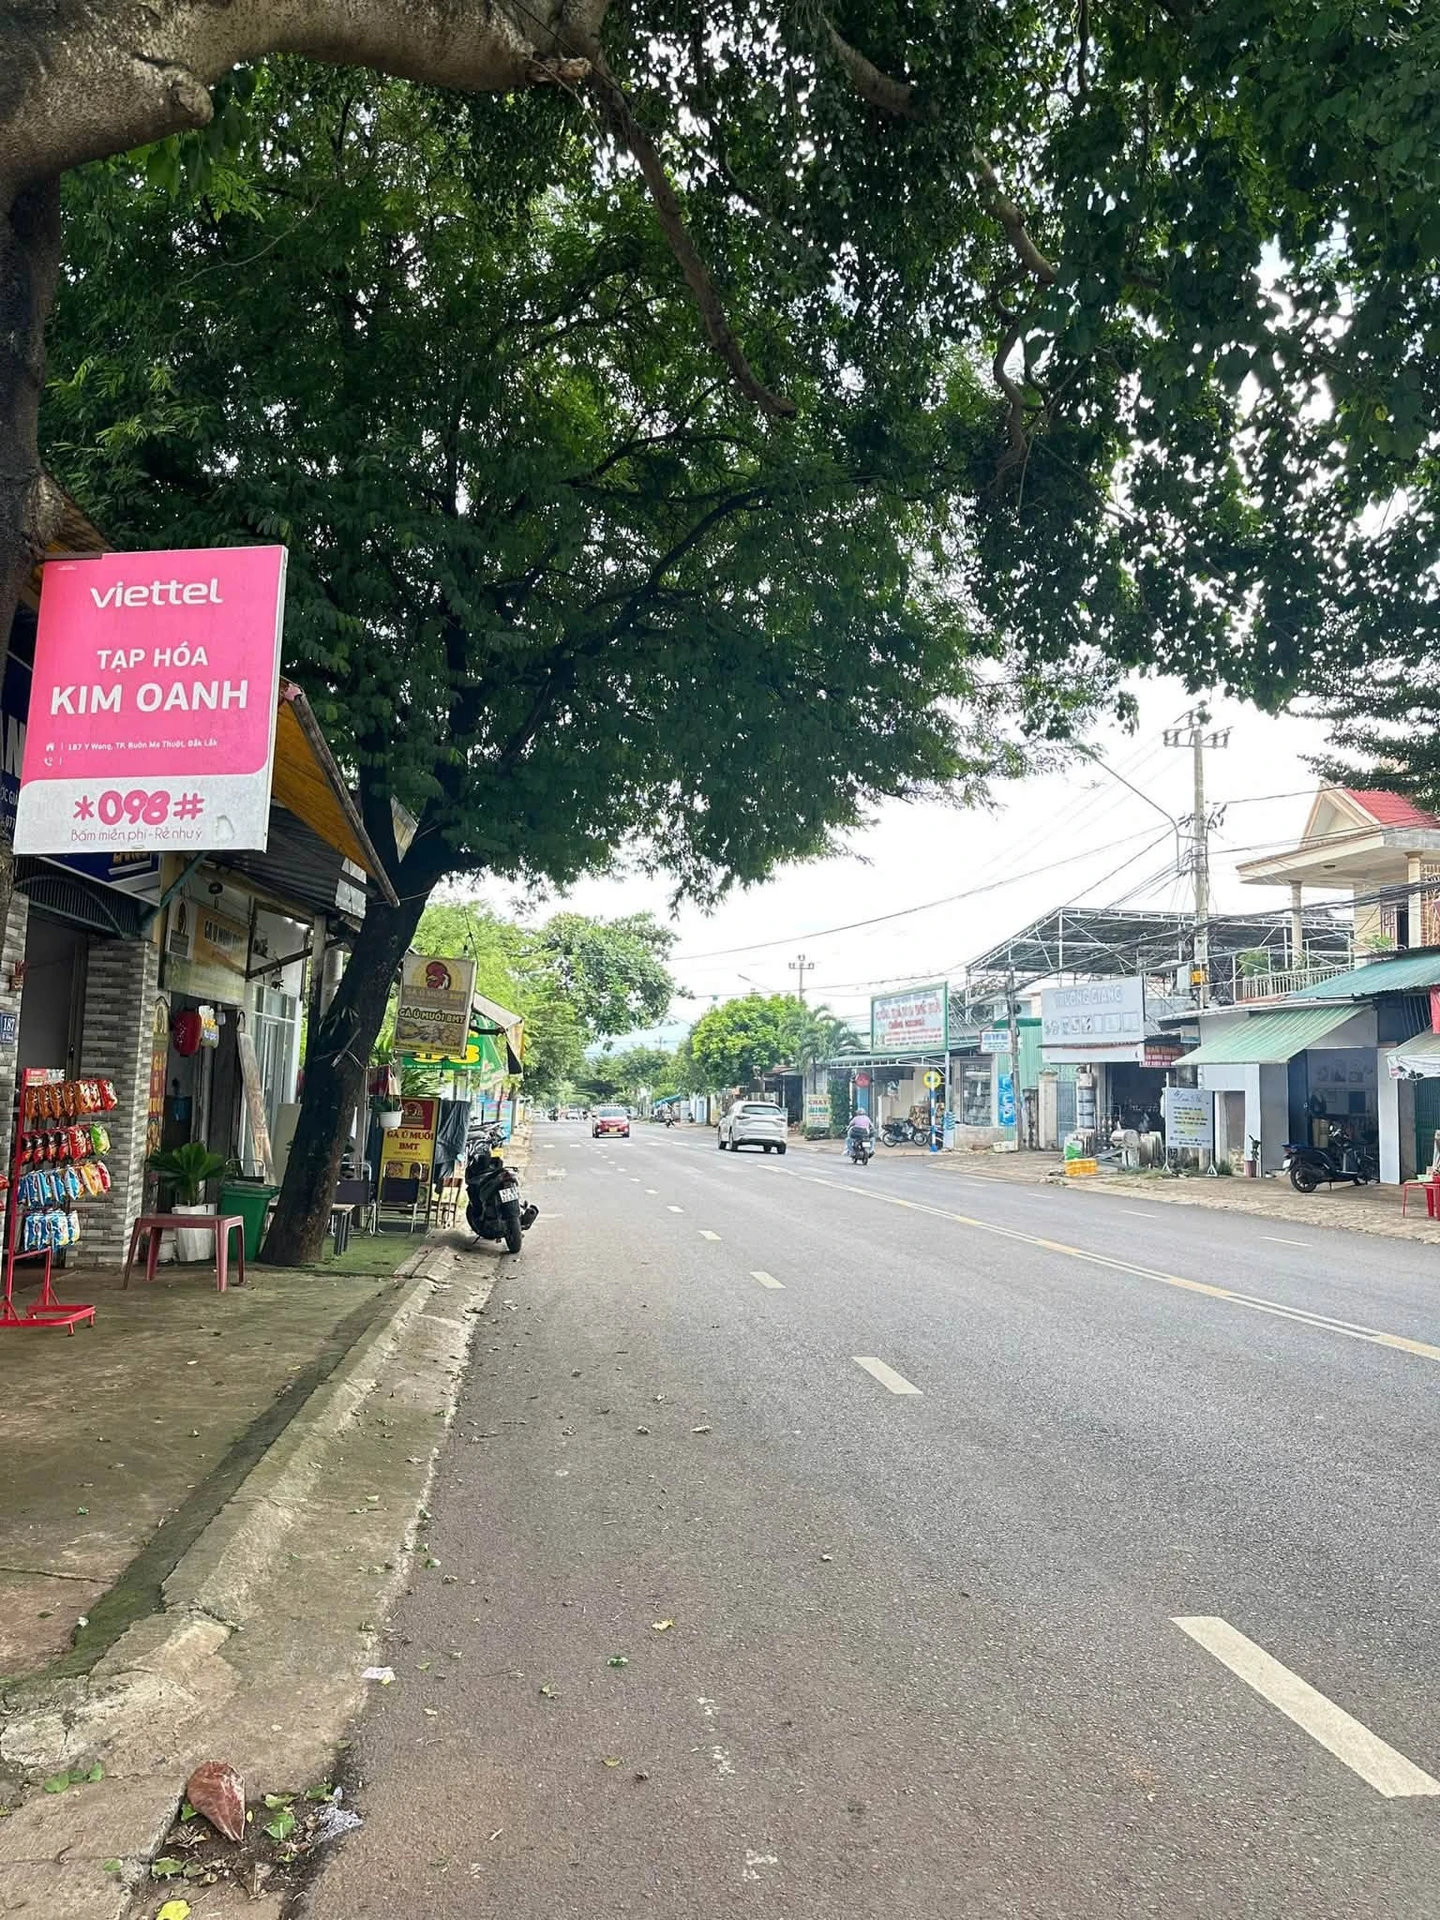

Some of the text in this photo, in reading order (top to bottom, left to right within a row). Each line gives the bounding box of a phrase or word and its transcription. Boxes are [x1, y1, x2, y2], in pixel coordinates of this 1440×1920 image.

[90, 578, 224, 608] viettel
[97, 641, 209, 674] TẠP HÓA
[50, 679, 249, 715] KIM OANH
[68, 743, 82, 751] 187
[398, 1007, 412, 1018] GÀ
[421, 1009, 445, 1022] MUỐI
[446, 1013, 467, 1024] BMT
[3, 1017, 15, 1031] 187
[387, 1129, 399, 1139] GÀ
[409, 1130, 434, 1141] MUỐI
[398, 1142, 420, 1150] BMT
